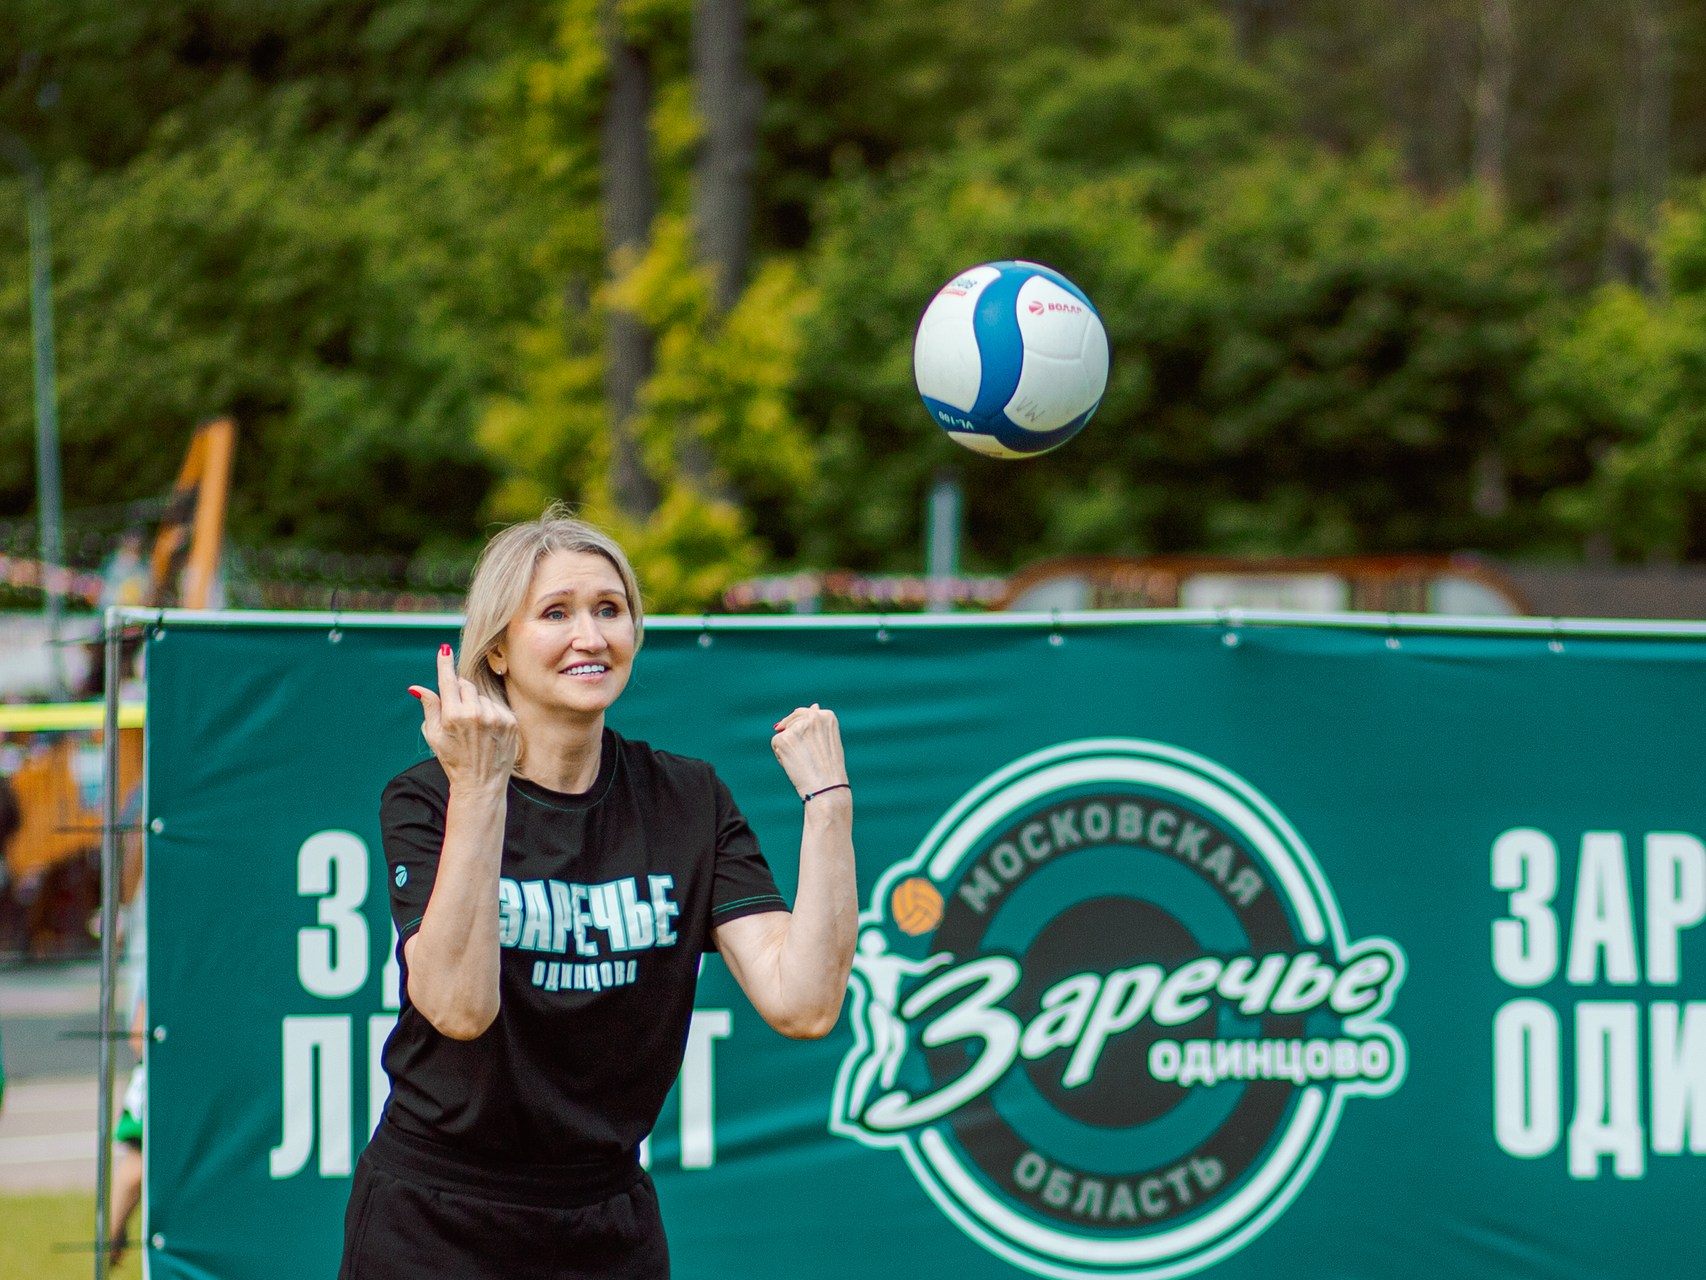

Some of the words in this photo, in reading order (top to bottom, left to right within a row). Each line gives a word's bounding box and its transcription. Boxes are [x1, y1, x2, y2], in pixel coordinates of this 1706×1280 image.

[959, 804, 1265, 913] МОСКОВСКАЯ
[864, 952, 1392, 1129] Заречье
[1150, 1039, 1391, 1085] ОДИНЦОВО
[1012, 1152, 1226, 1222] ОБЛАСТЬ
